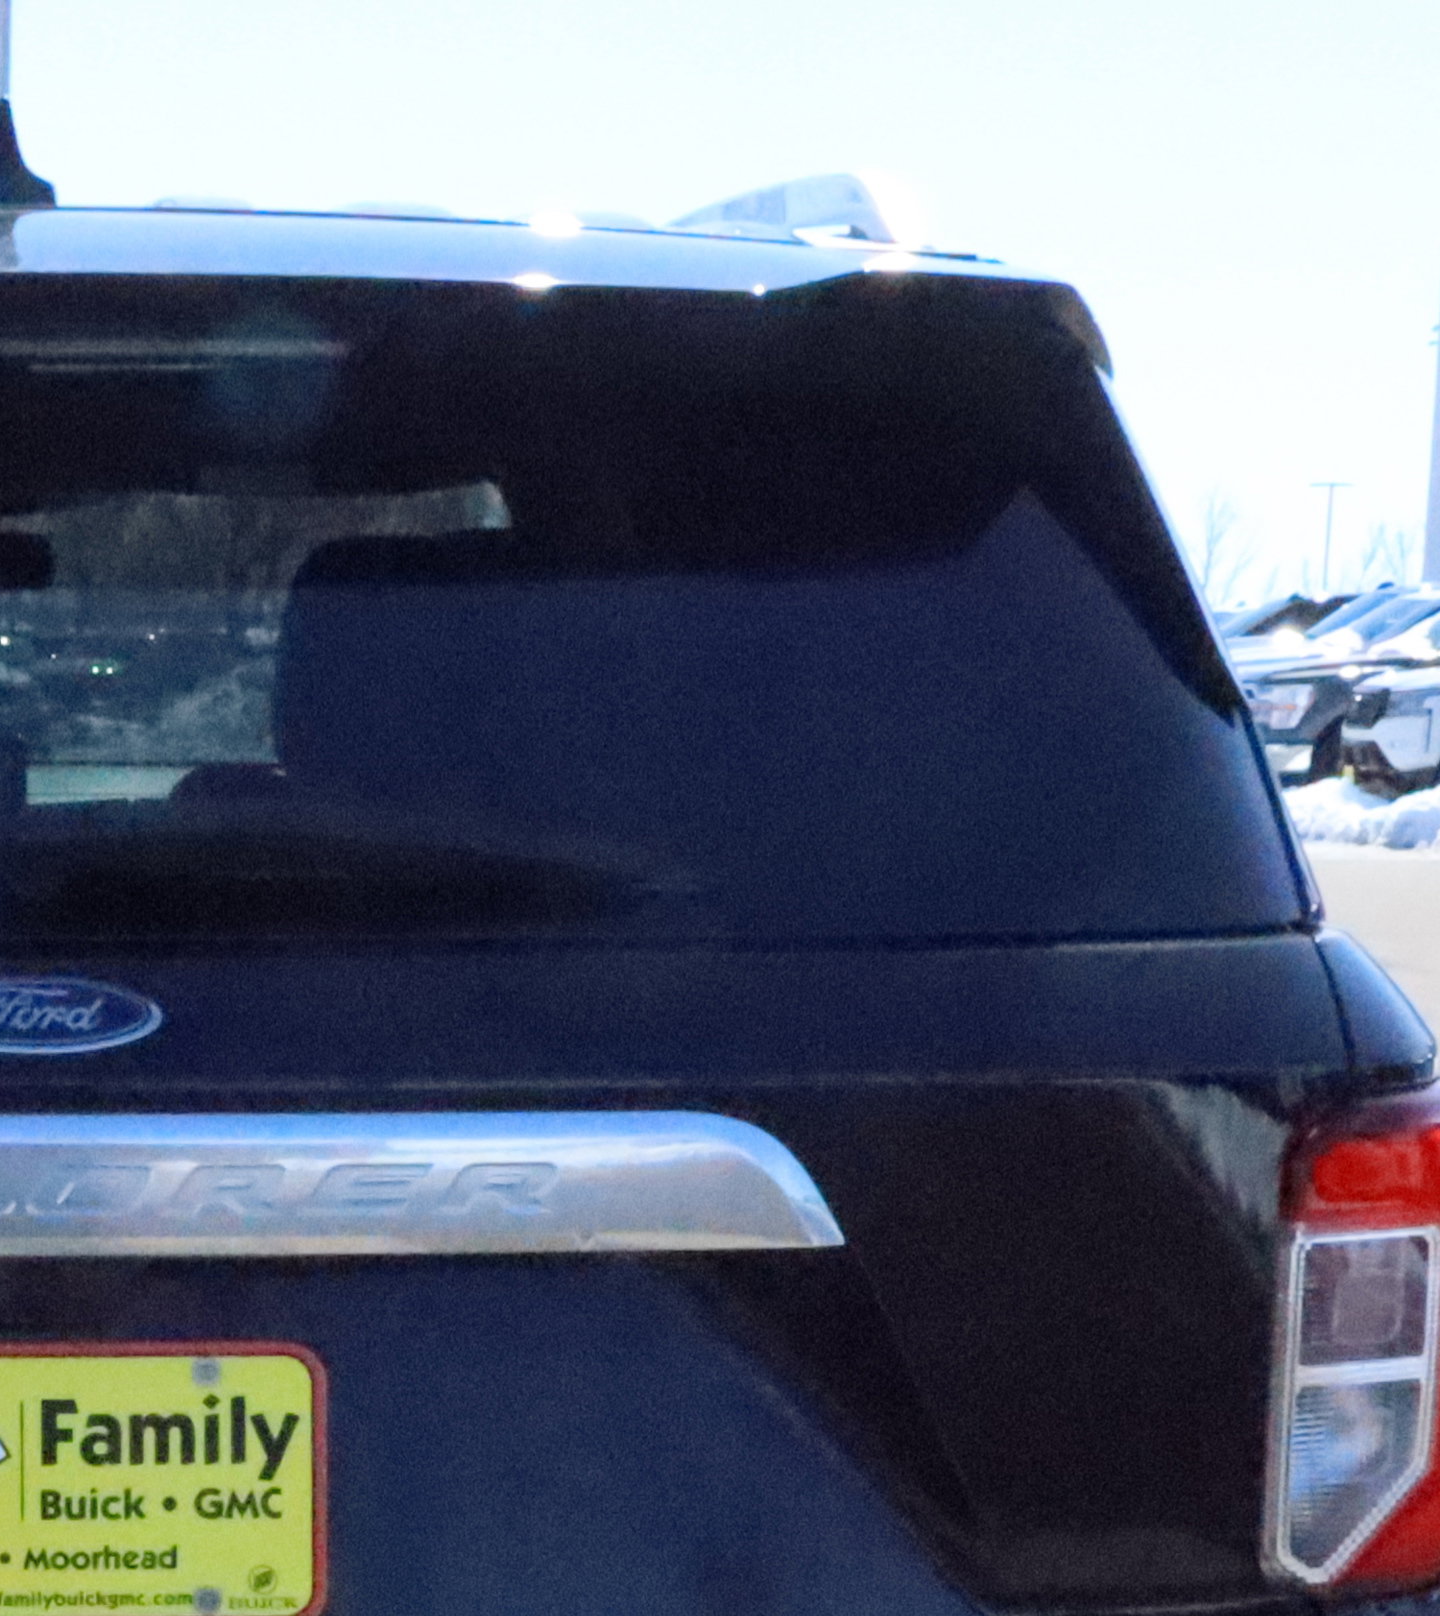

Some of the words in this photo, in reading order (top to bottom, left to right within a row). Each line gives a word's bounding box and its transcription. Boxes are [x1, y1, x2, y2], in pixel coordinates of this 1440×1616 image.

[40, 1394, 300, 1481] Family
[41, 1488, 146, 1520] Buick
[194, 1487, 283, 1519] GMC
[23, 1545, 178, 1570] Moorhead
